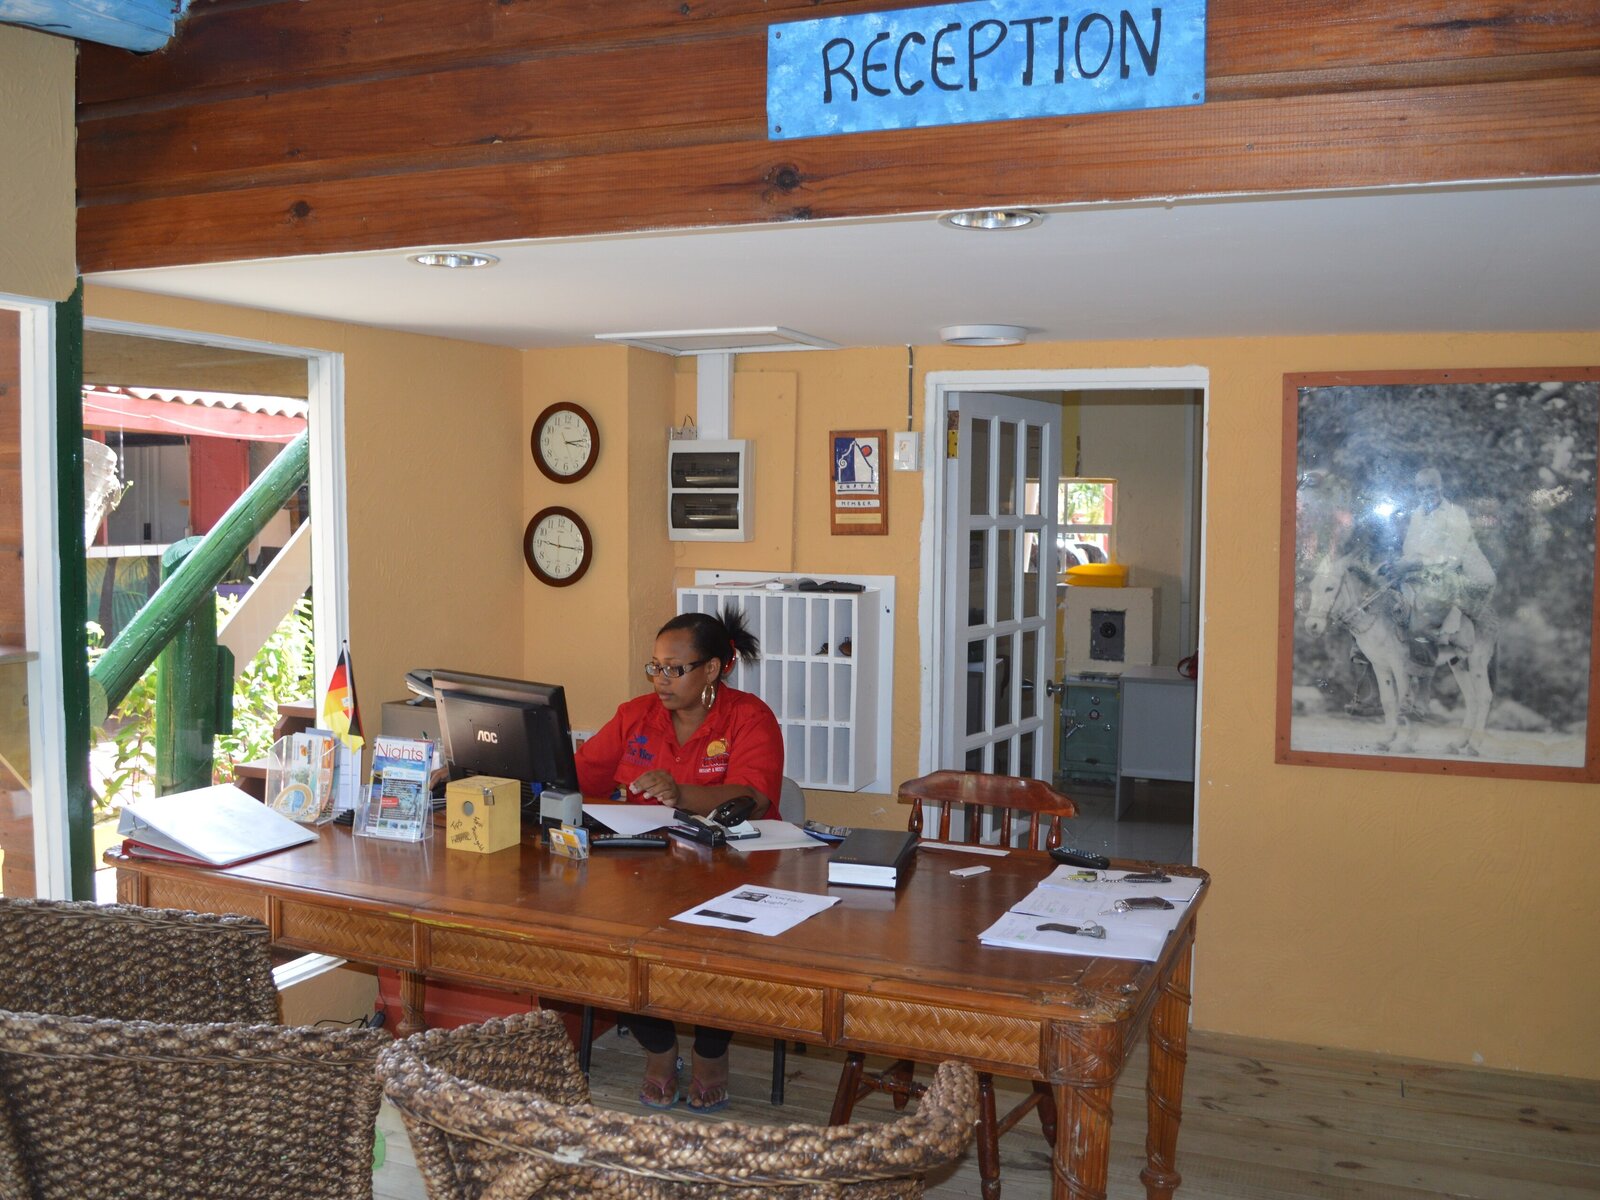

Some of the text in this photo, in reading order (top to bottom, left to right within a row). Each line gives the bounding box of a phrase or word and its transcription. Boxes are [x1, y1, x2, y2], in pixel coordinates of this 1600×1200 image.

[821, 7, 1162, 104] RECEPTION
[477, 730, 498, 744] AOC
[377, 743, 424, 761] Nights
